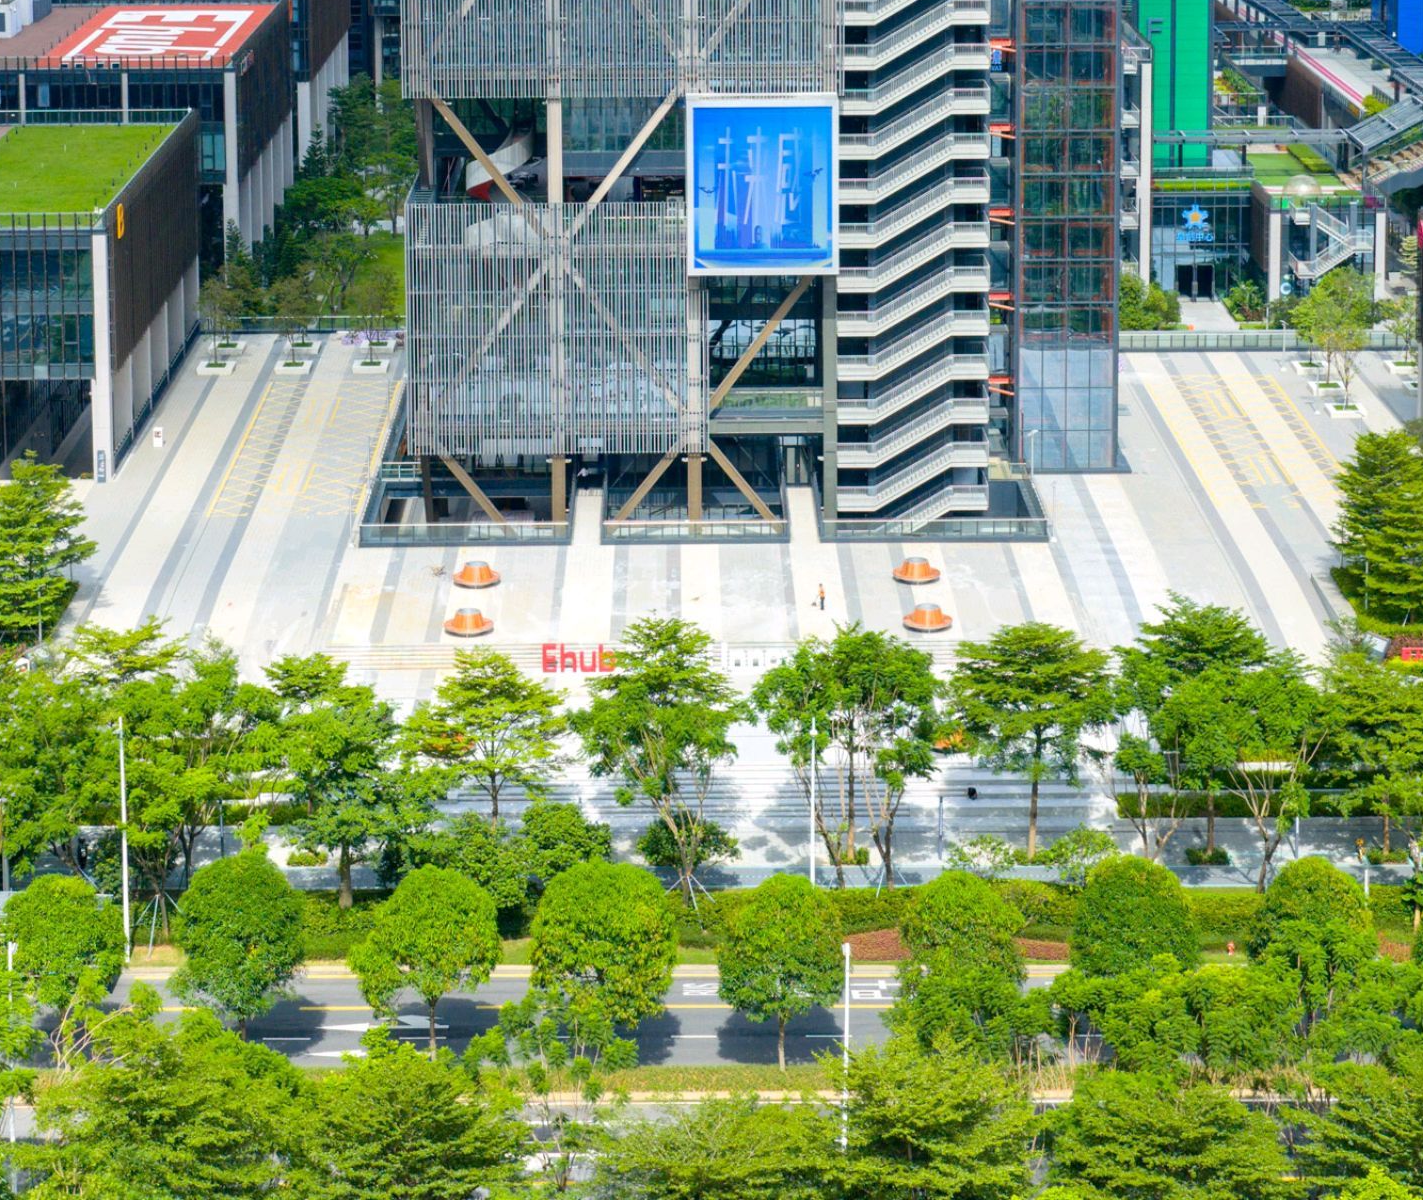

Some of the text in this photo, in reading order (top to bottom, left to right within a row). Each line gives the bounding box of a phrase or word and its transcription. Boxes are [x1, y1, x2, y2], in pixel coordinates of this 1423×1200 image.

[1146, 17, 1163, 44] F
[116, 203, 125, 240] B
[542, 643, 615, 672] Ehub
